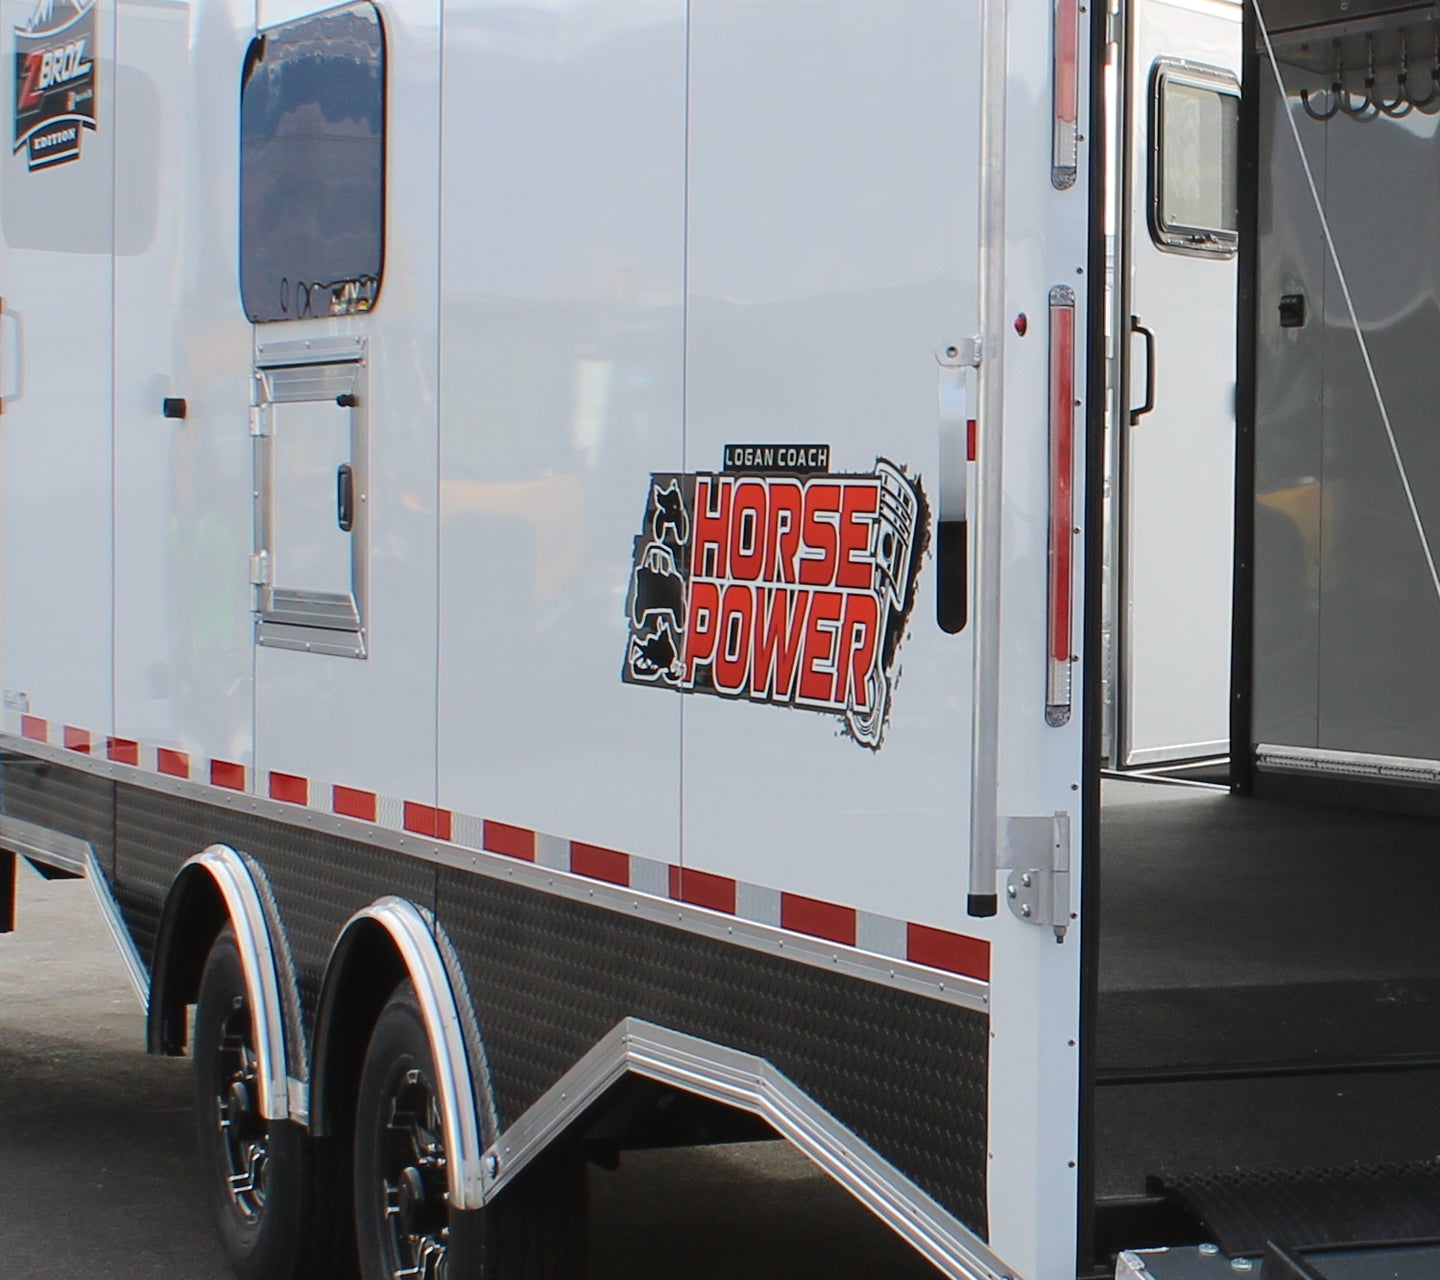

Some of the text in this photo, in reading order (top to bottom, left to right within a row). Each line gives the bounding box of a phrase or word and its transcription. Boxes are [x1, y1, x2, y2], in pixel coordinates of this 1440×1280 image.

[33, 128, 76, 150] EDITION
[725, 447, 828, 468] LOGAN COACH
[691, 477, 881, 590] HORSE
[681, 580, 881, 712] POWER
